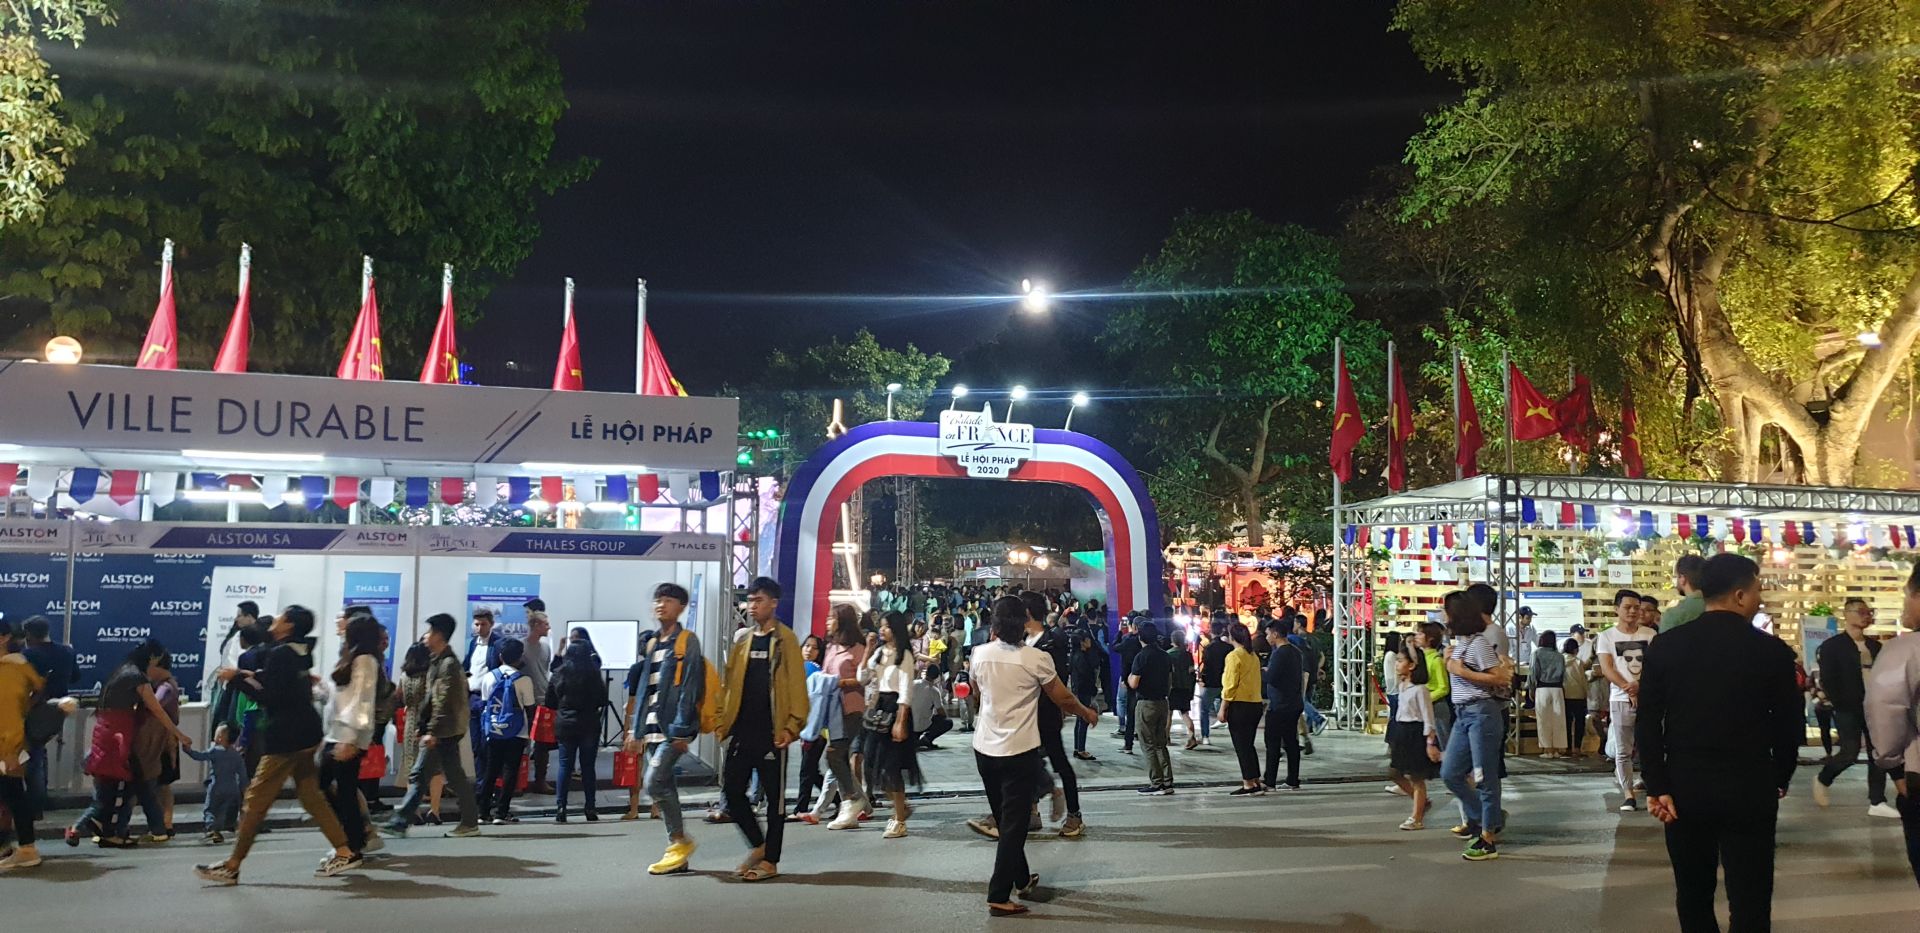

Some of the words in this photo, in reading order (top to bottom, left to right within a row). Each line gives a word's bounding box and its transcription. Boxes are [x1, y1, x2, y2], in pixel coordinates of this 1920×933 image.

[68, 391, 192, 433] VILLE
[217, 398, 424, 443] DURABLE
[571, 414, 593, 439] LỄ
[602, 420, 644, 445] HỘI
[653, 422, 713, 444] PHÁP
[977, 466, 1000, 475] 2020
[0, 528, 58, 538] ALSTOM
[356, 532, 407, 542] ALSTOM
[207, 533, 268, 545] ALSTOM
[273, 533, 291, 545] SA
[526, 539, 575, 551] THALES
[580, 540, 626, 552] GROUP
[670, 542, 716, 550] THALES
[101, 574, 154, 584] ALSTOM
[225, 585, 267, 594] ALSTOM
[355, 585, 390, 593] THALES
[150, 601, 202, 610] ALSTOM
[97, 627, 151, 637] ALSTOM
